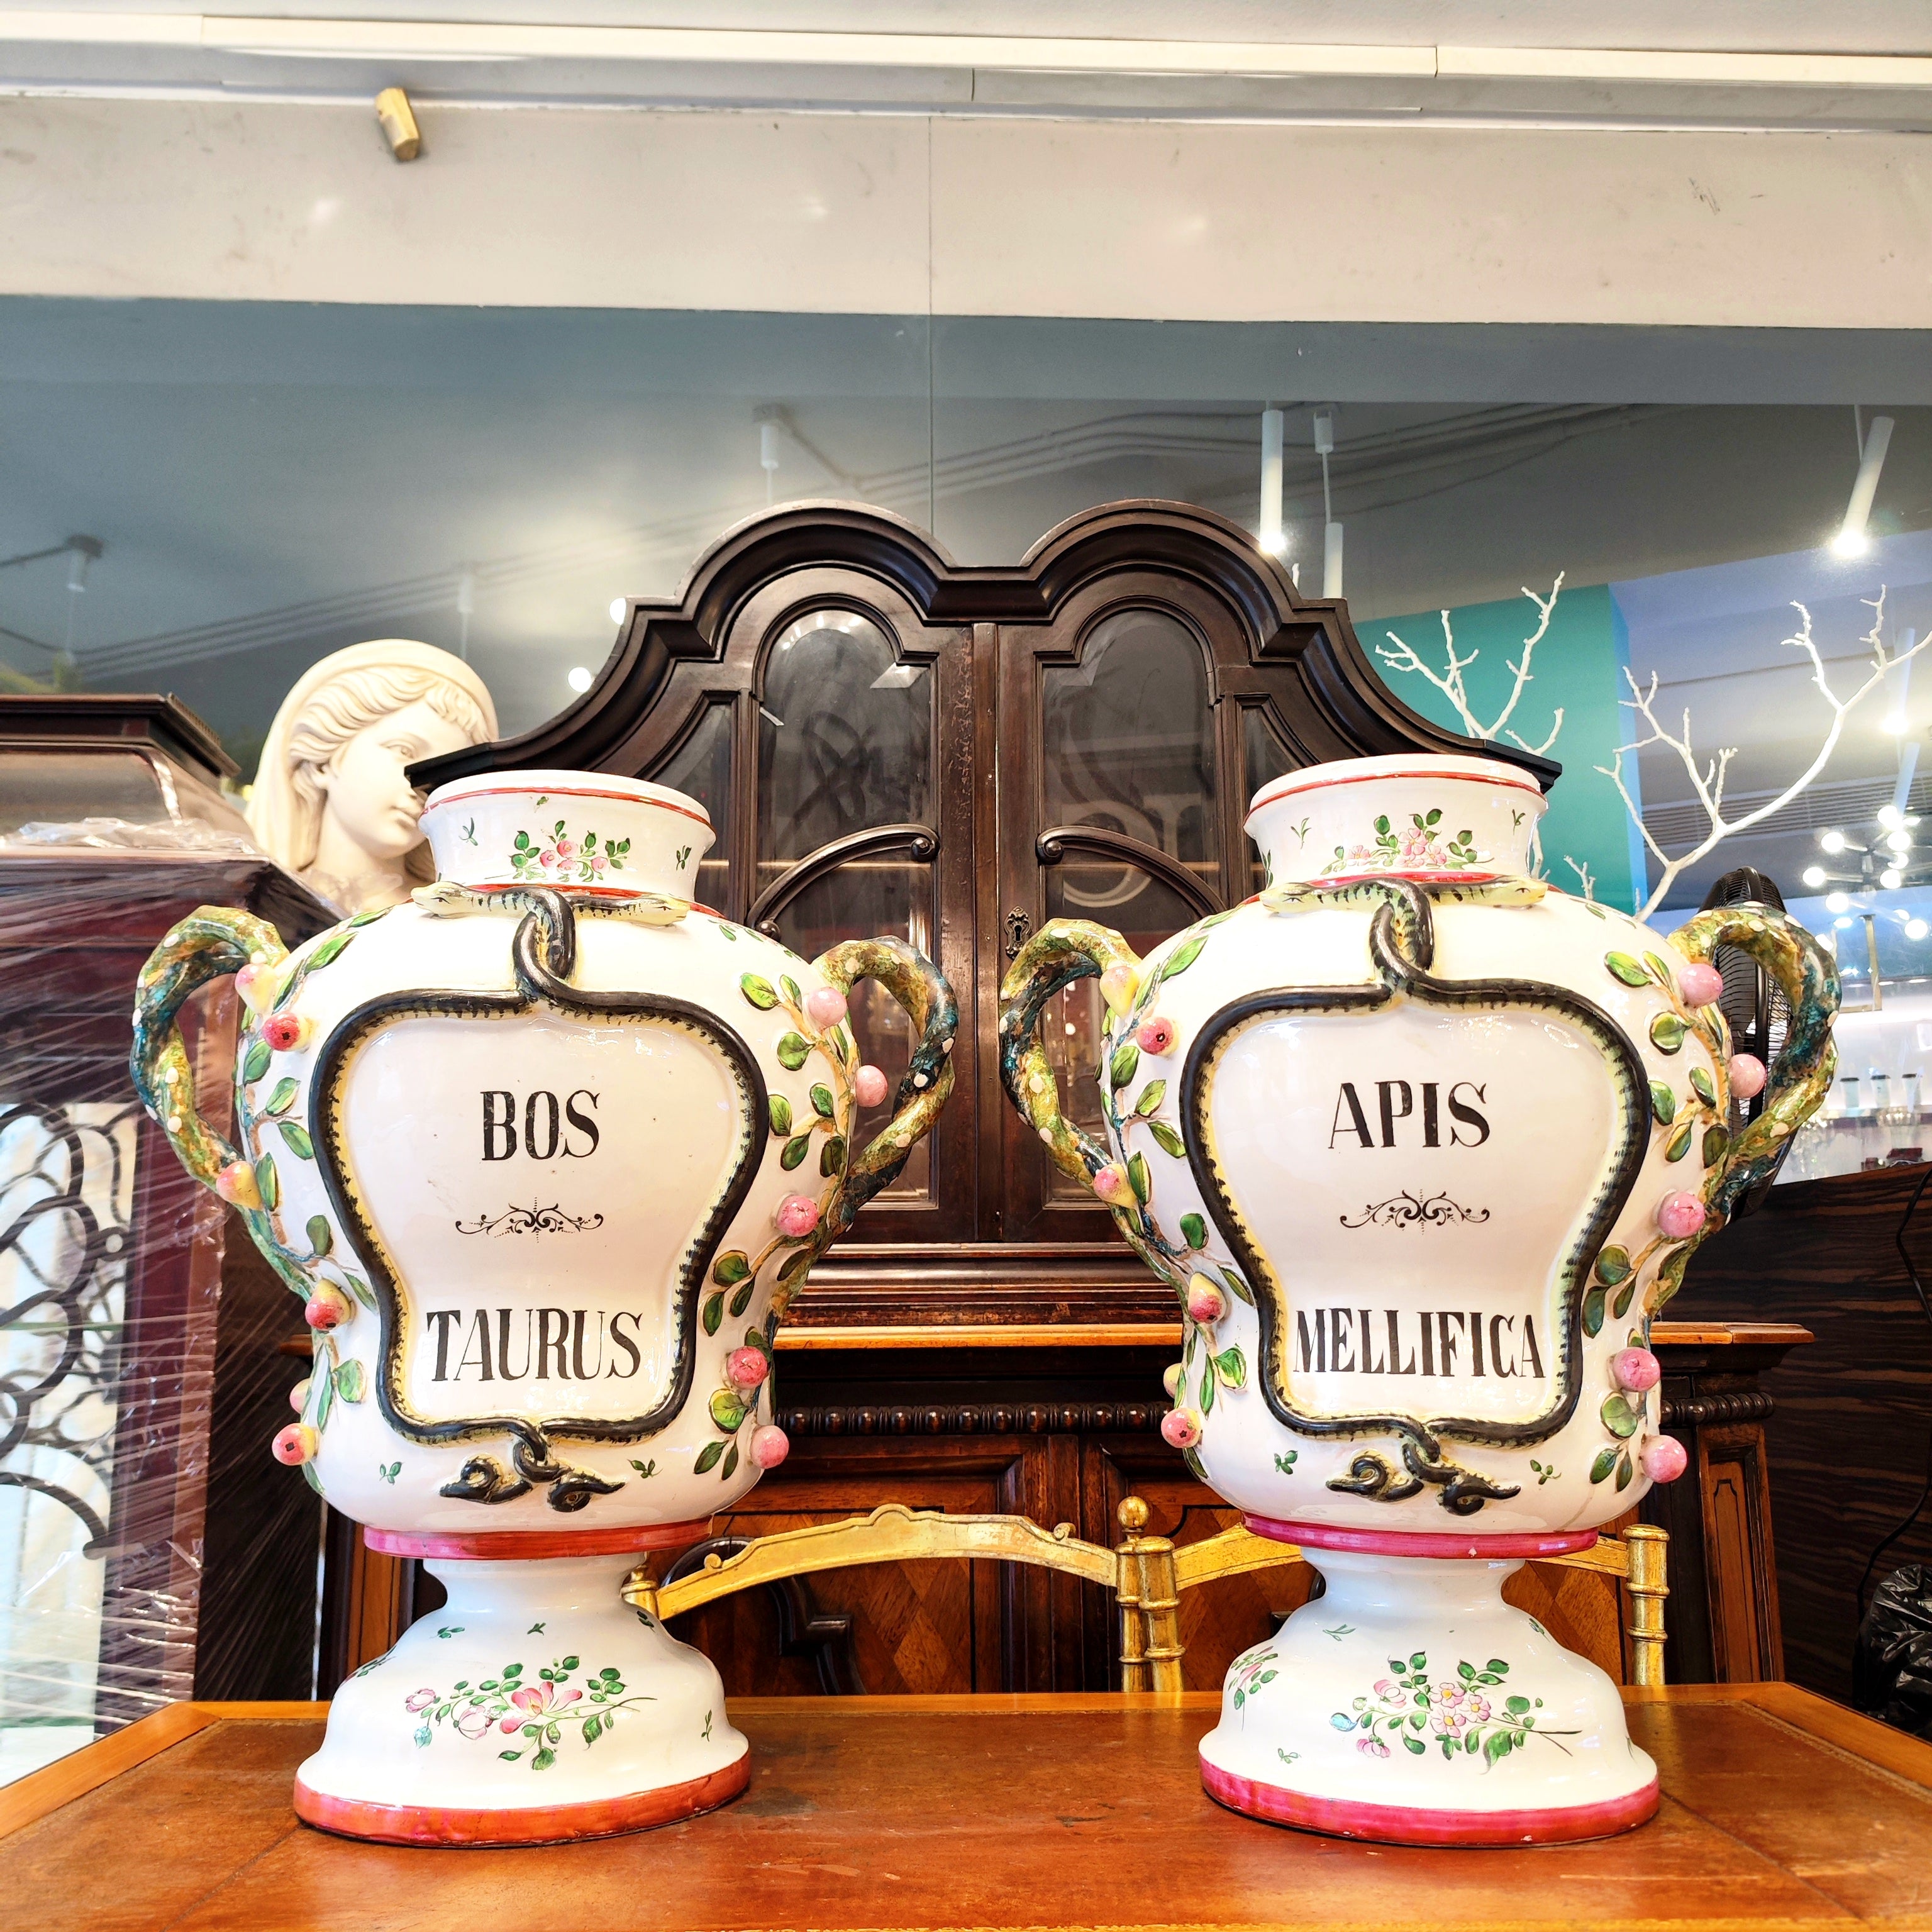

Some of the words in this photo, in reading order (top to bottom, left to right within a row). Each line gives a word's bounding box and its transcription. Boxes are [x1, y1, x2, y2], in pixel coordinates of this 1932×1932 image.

[480, 1089, 600, 1161] BOS
[1328, 1080, 1490, 1149] APIS
[426, 1308, 643, 1382] TAURUS
[1293, 1307, 1546, 1379] MELLIFICA
